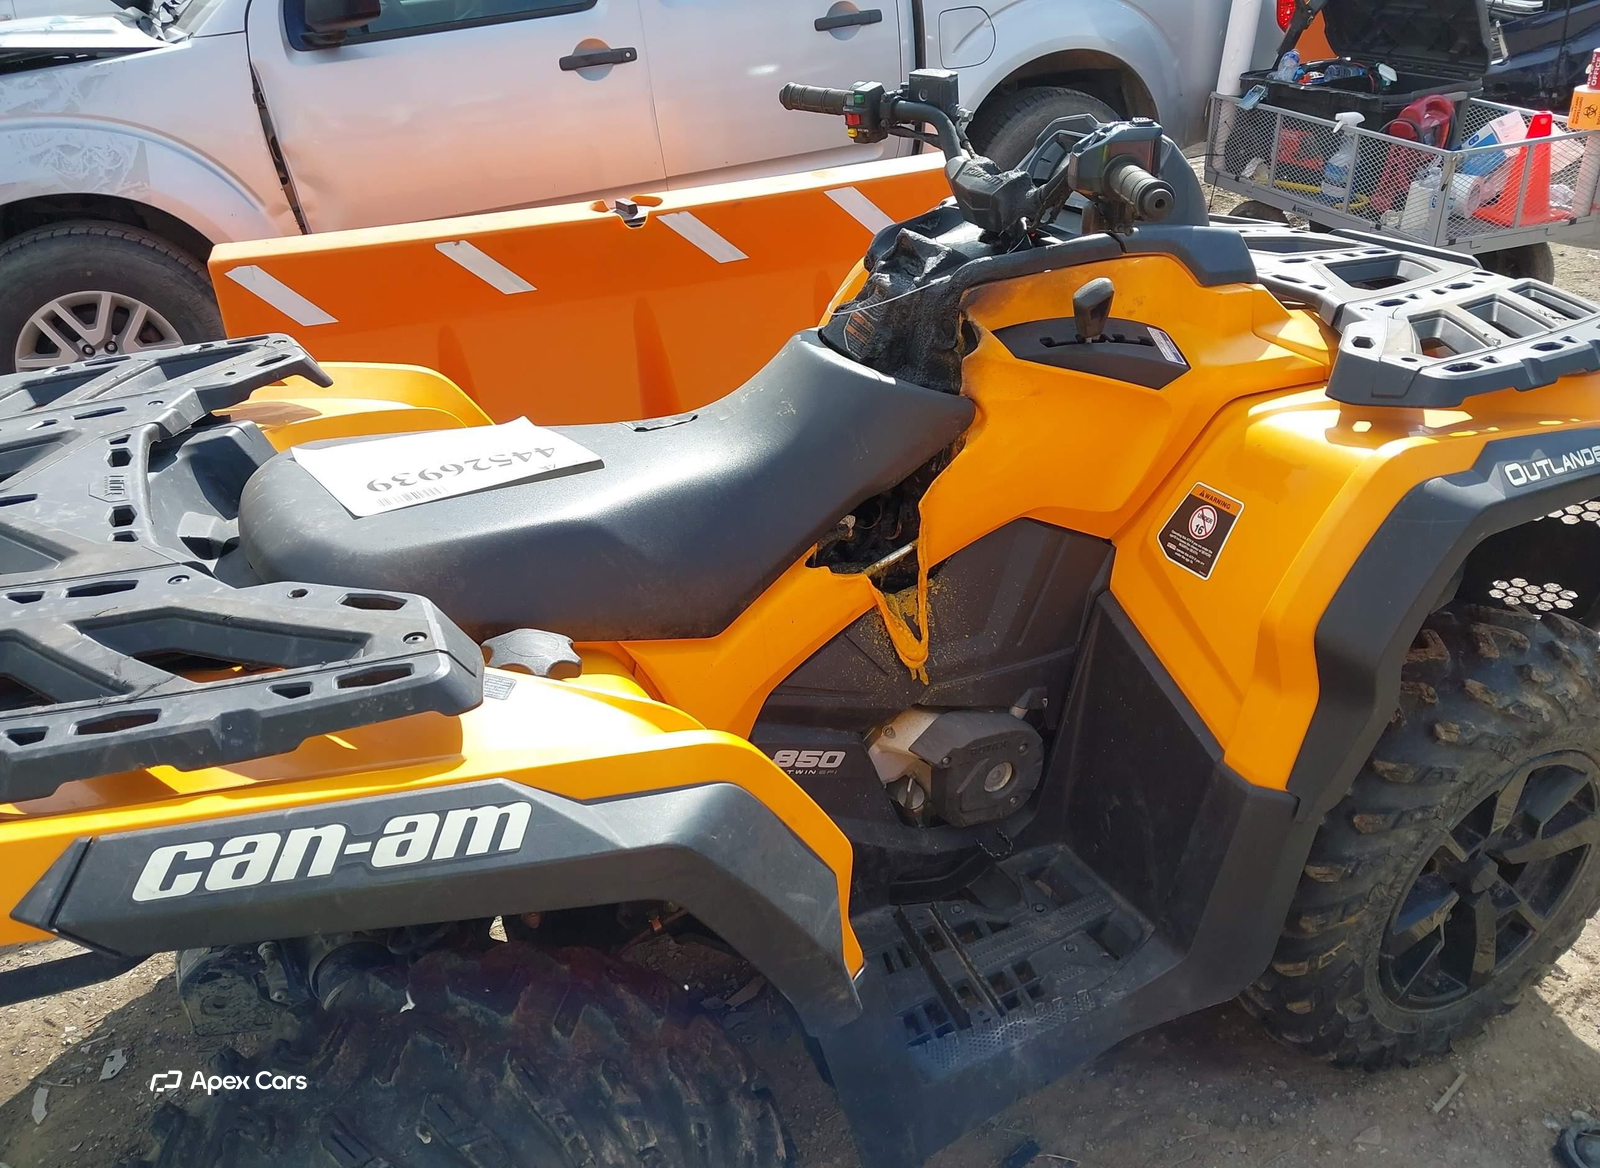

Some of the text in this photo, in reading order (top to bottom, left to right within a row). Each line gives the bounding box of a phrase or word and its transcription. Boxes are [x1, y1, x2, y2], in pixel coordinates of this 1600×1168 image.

[366, 447, 556, 492] 44526939
[1205, 492, 1232, 509] WARNING
[1197, 513, 1213, 524] UNDER
[1194, 524, 1204, 535] 16
[772, 749, 847, 768] 850
[131, 801, 533, 903] can-am
